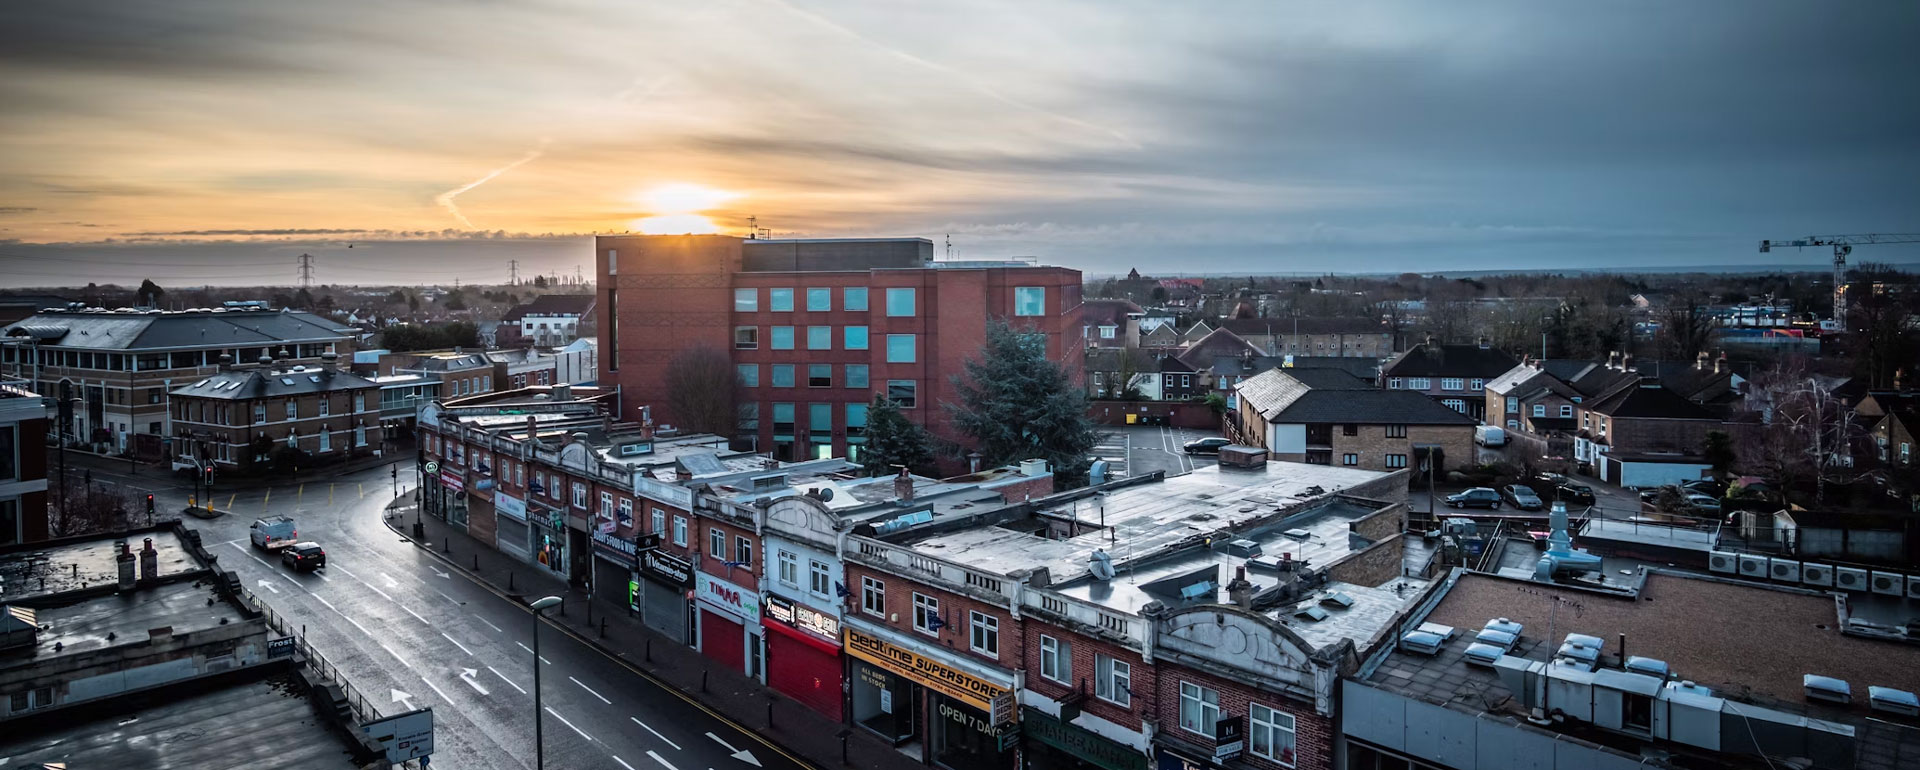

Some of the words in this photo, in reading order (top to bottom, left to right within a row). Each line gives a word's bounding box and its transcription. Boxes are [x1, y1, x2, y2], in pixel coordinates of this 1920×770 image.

[527, 511, 554, 529] pharmacy
[268, 638, 293, 649] Frost
[849, 629, 913, 664] bedtime
[861, 667, 871, 677] ALL
[871, 670, 886, 682] BEDS
[861, 674, 868, 683] IN
[868, 676, 886, 689] STOCK
[890, 665, 904, 676] LOCAL
[904, 671, 926, 684] DELIVERY
[996, 696, 1012, 708] BEDS
[996, 704, 1012, 716] BEDS
[996, 711, 1013, 724] BEDS
[939, 703, 967, 725] OPEN
[968, 716, 976, 727] 7
[976, 718, 1003, 738] DAYS
[1225, 725, 1233, 736] M
